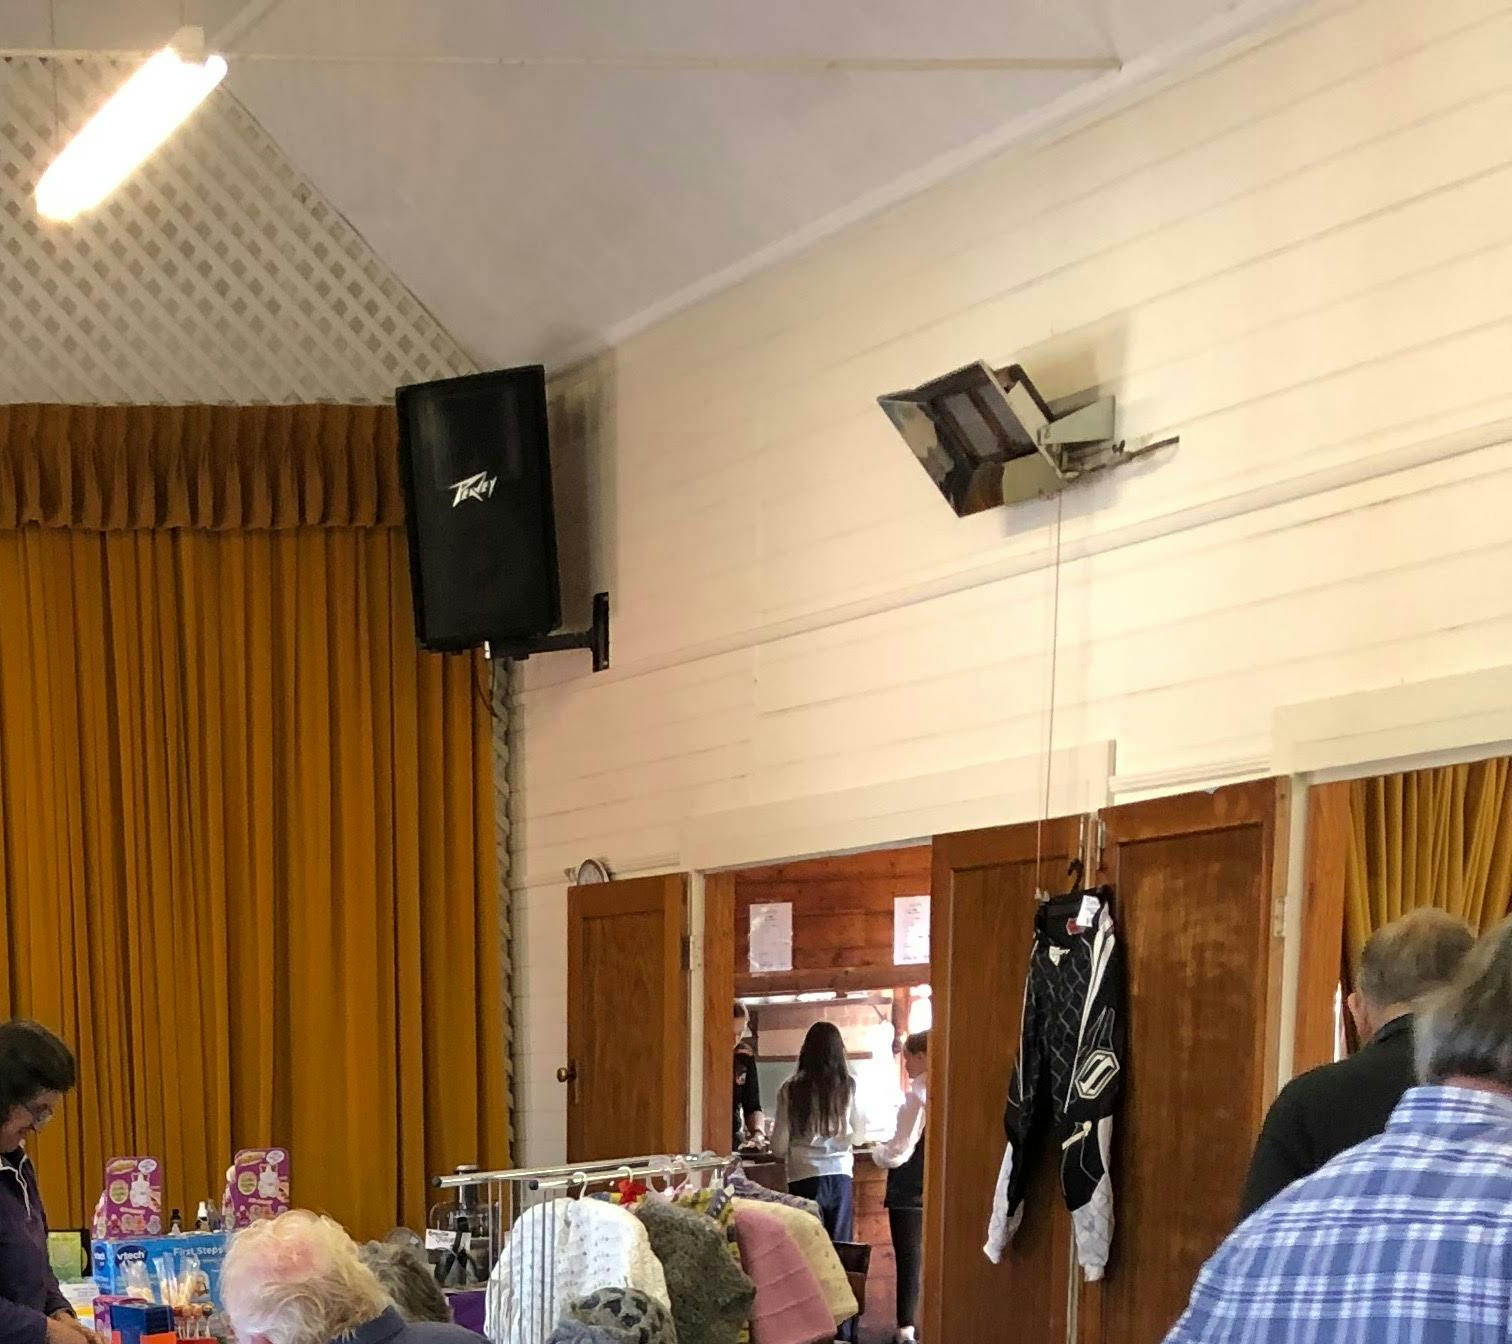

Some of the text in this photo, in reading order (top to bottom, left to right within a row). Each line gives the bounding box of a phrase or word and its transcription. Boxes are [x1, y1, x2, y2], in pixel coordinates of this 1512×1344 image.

[116, 1250, 145, 1261] vtech
[173, 1246, 224, 1256] First Steps
